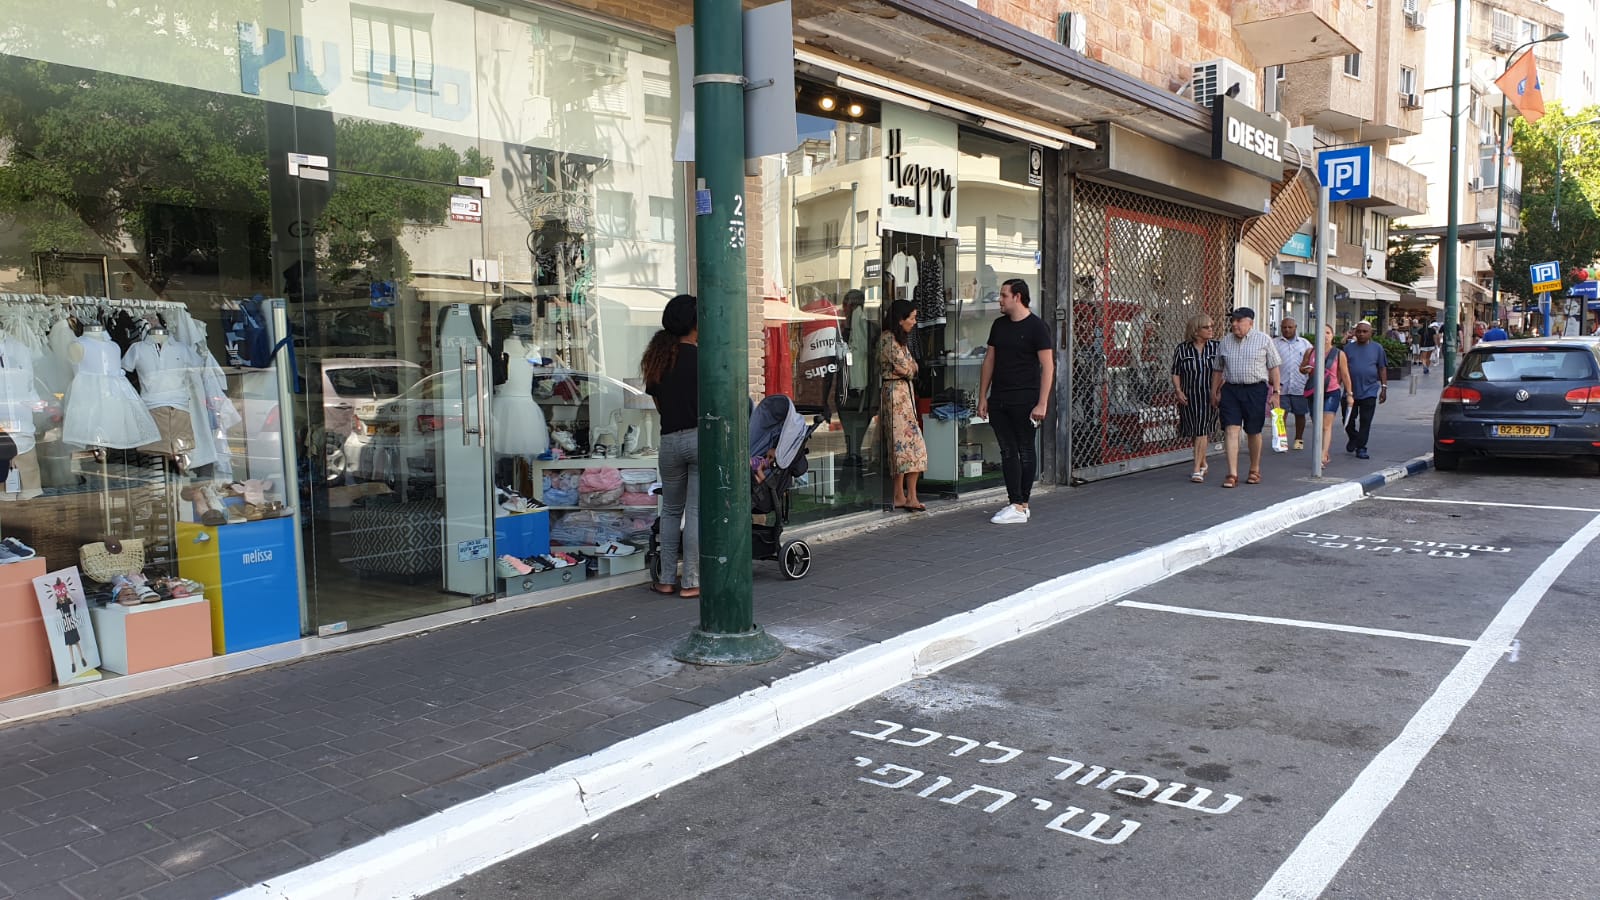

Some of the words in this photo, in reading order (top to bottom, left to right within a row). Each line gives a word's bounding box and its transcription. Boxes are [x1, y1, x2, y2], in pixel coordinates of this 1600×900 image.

[1227, 116, 1282, 163] DIESEL
[885, 128, 955, 218] Happy
[734, 194, 743, 216] 2
[242, 548, 273, 565] melissa
[850, 719, 1024, 764] לרכב
[1046, 756, 1243, 814] שמור
